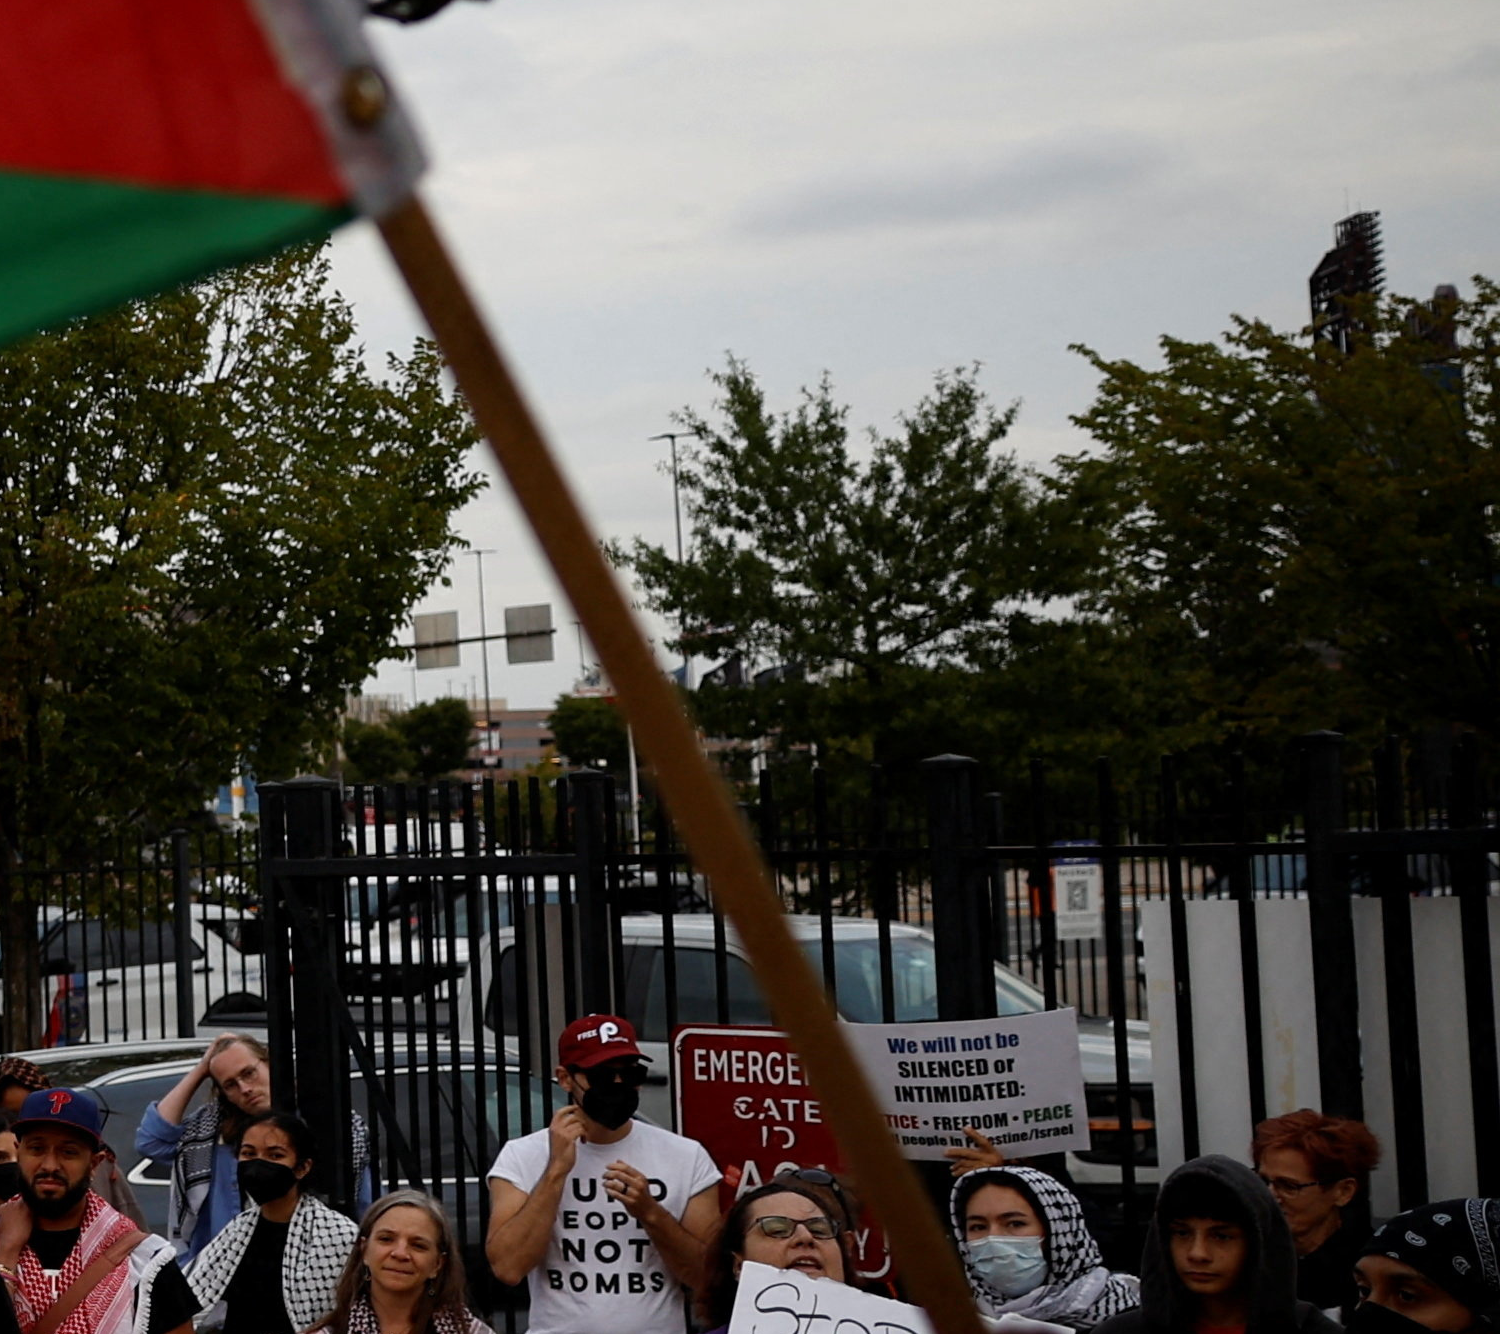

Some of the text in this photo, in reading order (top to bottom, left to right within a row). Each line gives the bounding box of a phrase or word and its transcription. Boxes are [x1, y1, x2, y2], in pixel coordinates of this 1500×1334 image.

[887, 1033, 1019, 1054] We will not be
[693, 1048, 810, 1086] EMERGE
[898, 1058, 1015, 1078] SILENCED or
[894, 1080, 1026, 1103] INTIMIDATED:
[885, 1104, 1073, 1131] TICE FREEDOM PEACE
[902, 1135, 947, 1148] people
[950, 1135, 964, 1147] in
[562, 1238, 650, 1263] NOT
[547, 1269, 664, 1294] BOMBS
